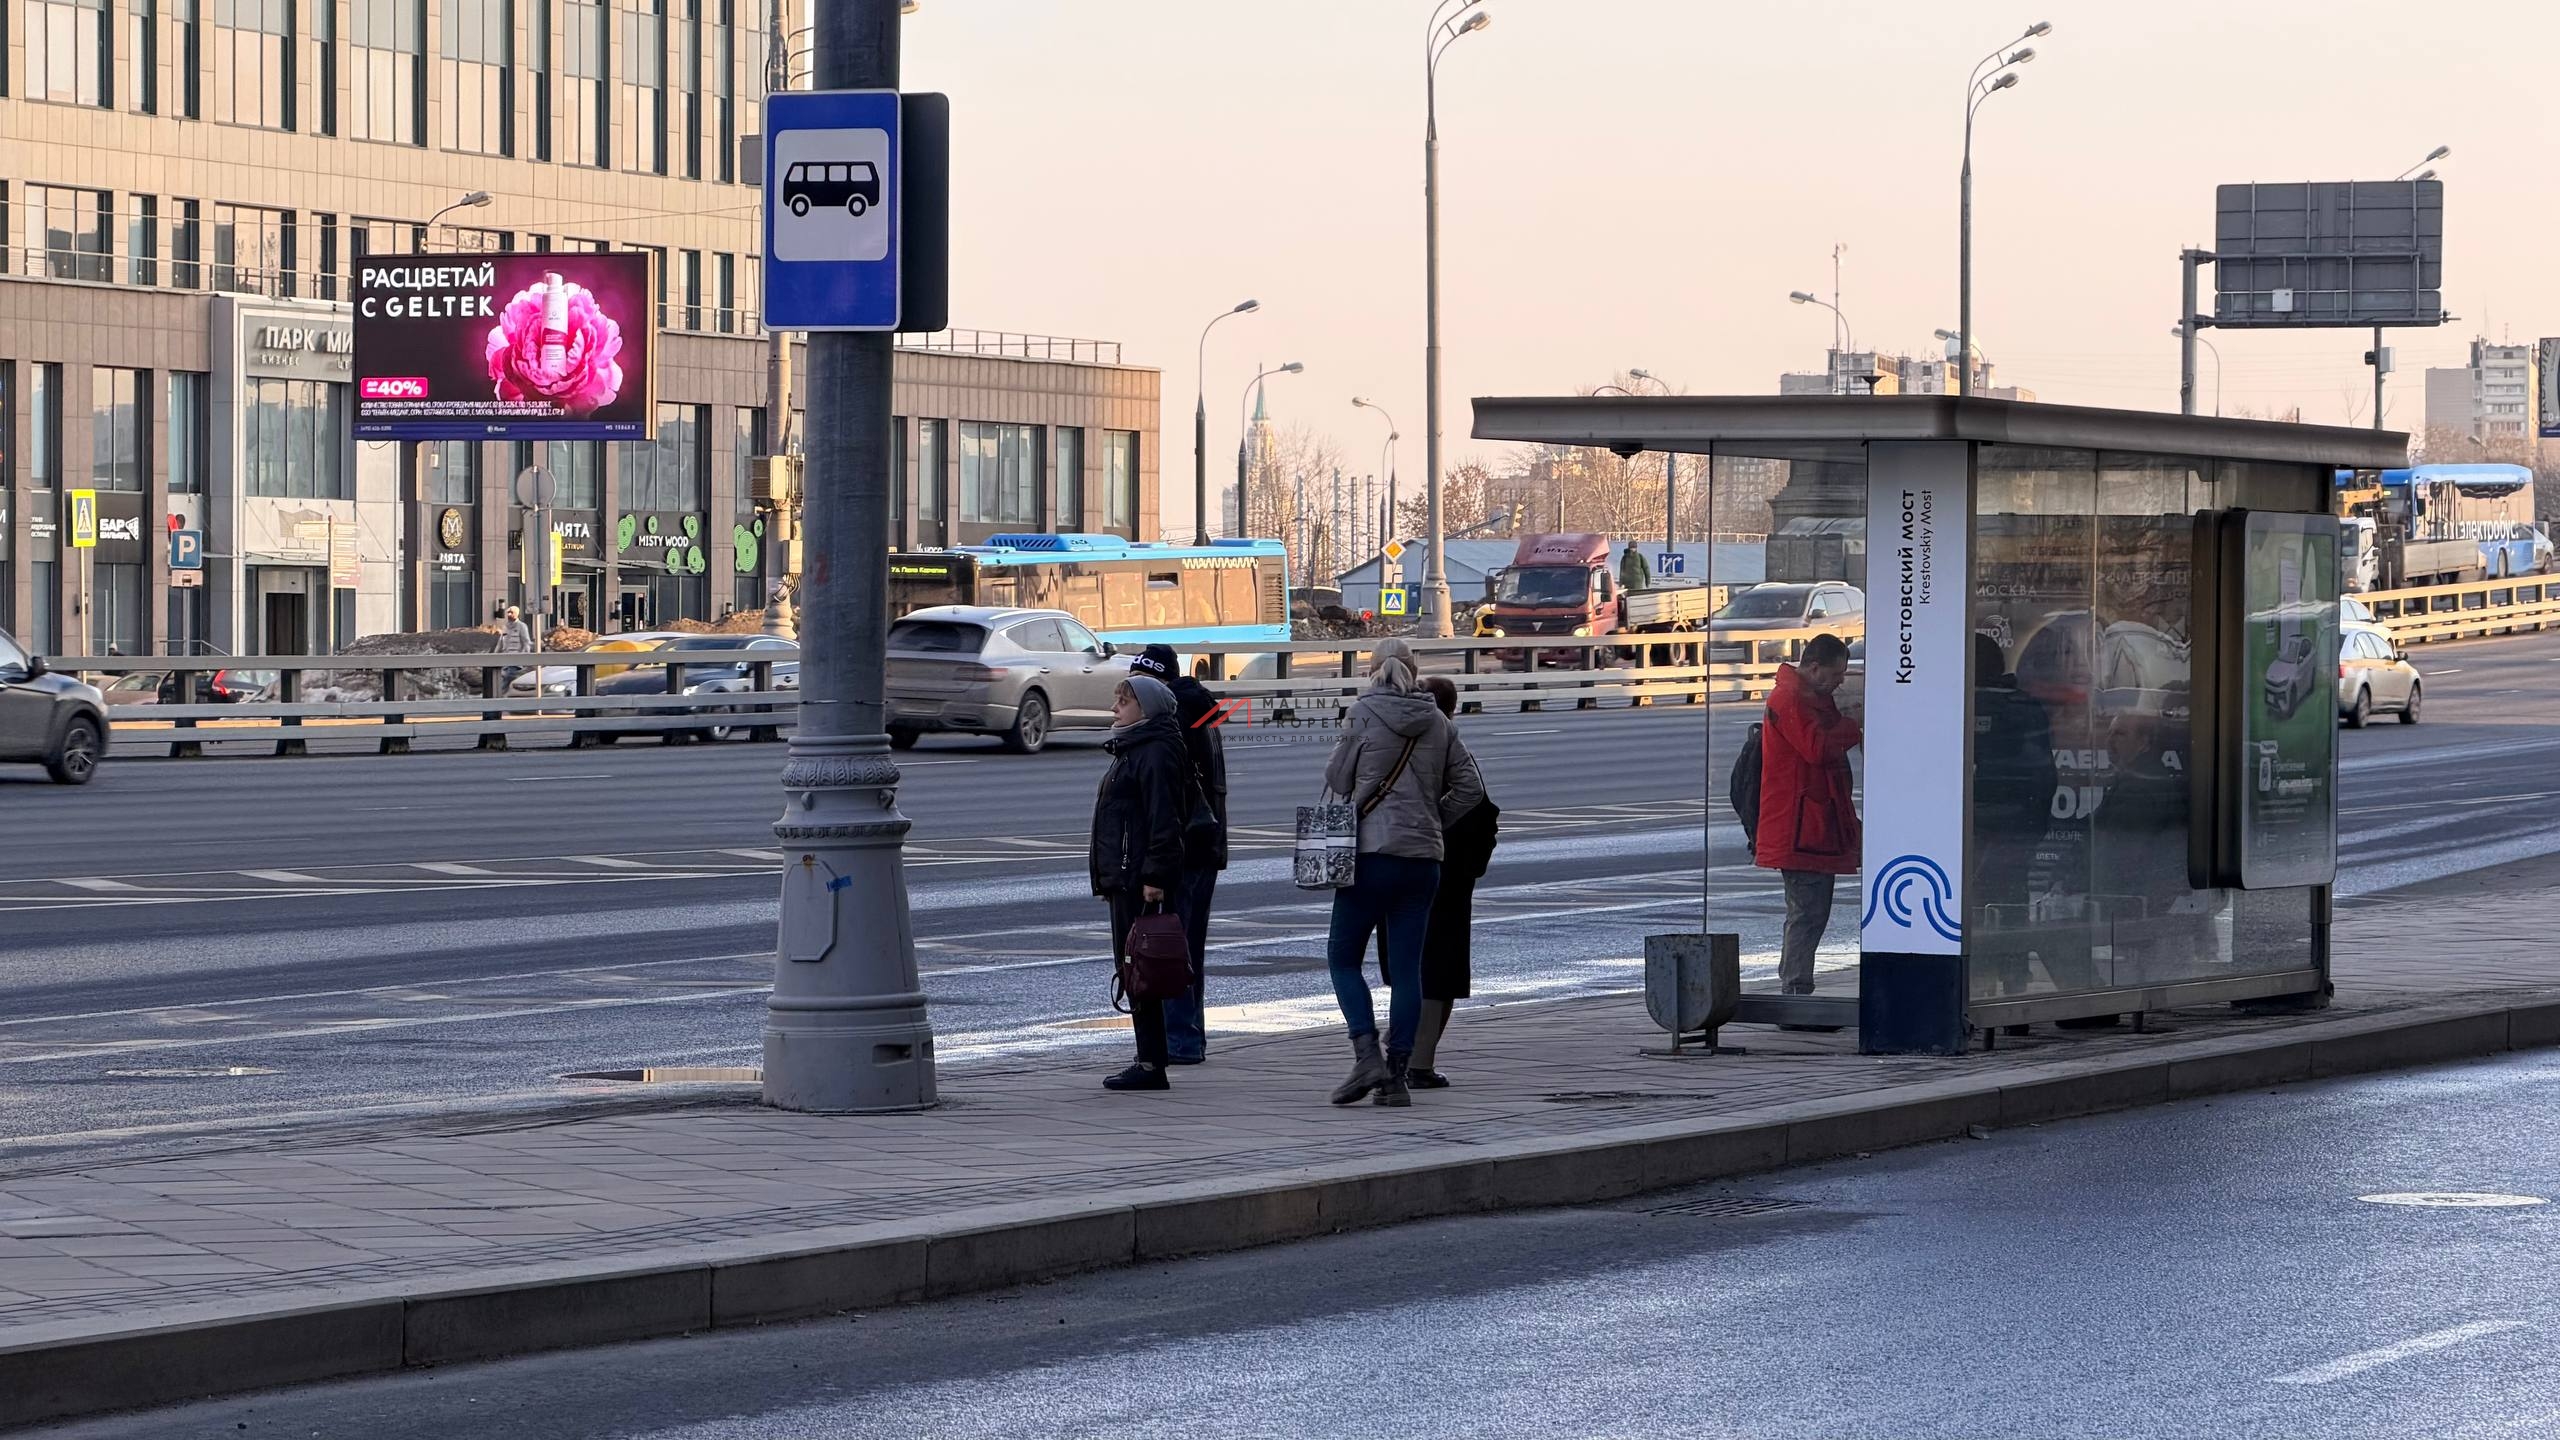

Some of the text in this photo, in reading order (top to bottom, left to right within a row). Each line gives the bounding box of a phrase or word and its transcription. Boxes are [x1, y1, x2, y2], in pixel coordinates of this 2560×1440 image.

[362, 262, 494, 290] РАСЦВЕТАЙ
[386, 296, 494, 317] GELTEK
[266, 326, 352, 353] ПАРК МИ
[262, 354, 299, 366] БИЗНЕС
[99, 518, 125, 531] БАР
[554, 521, 590, 538] МЯТА
[562, 543, 585, 551] LATINUM
[639, 535, 689, 547] MISTY WOOD
[1920, 489, 1932, 605] Krestovskiy Most
[440, 553, 465, 564] МЯТА
[1896, 550, 1916, 684] Крестовский
[1133, 654, 1166, 673] das
